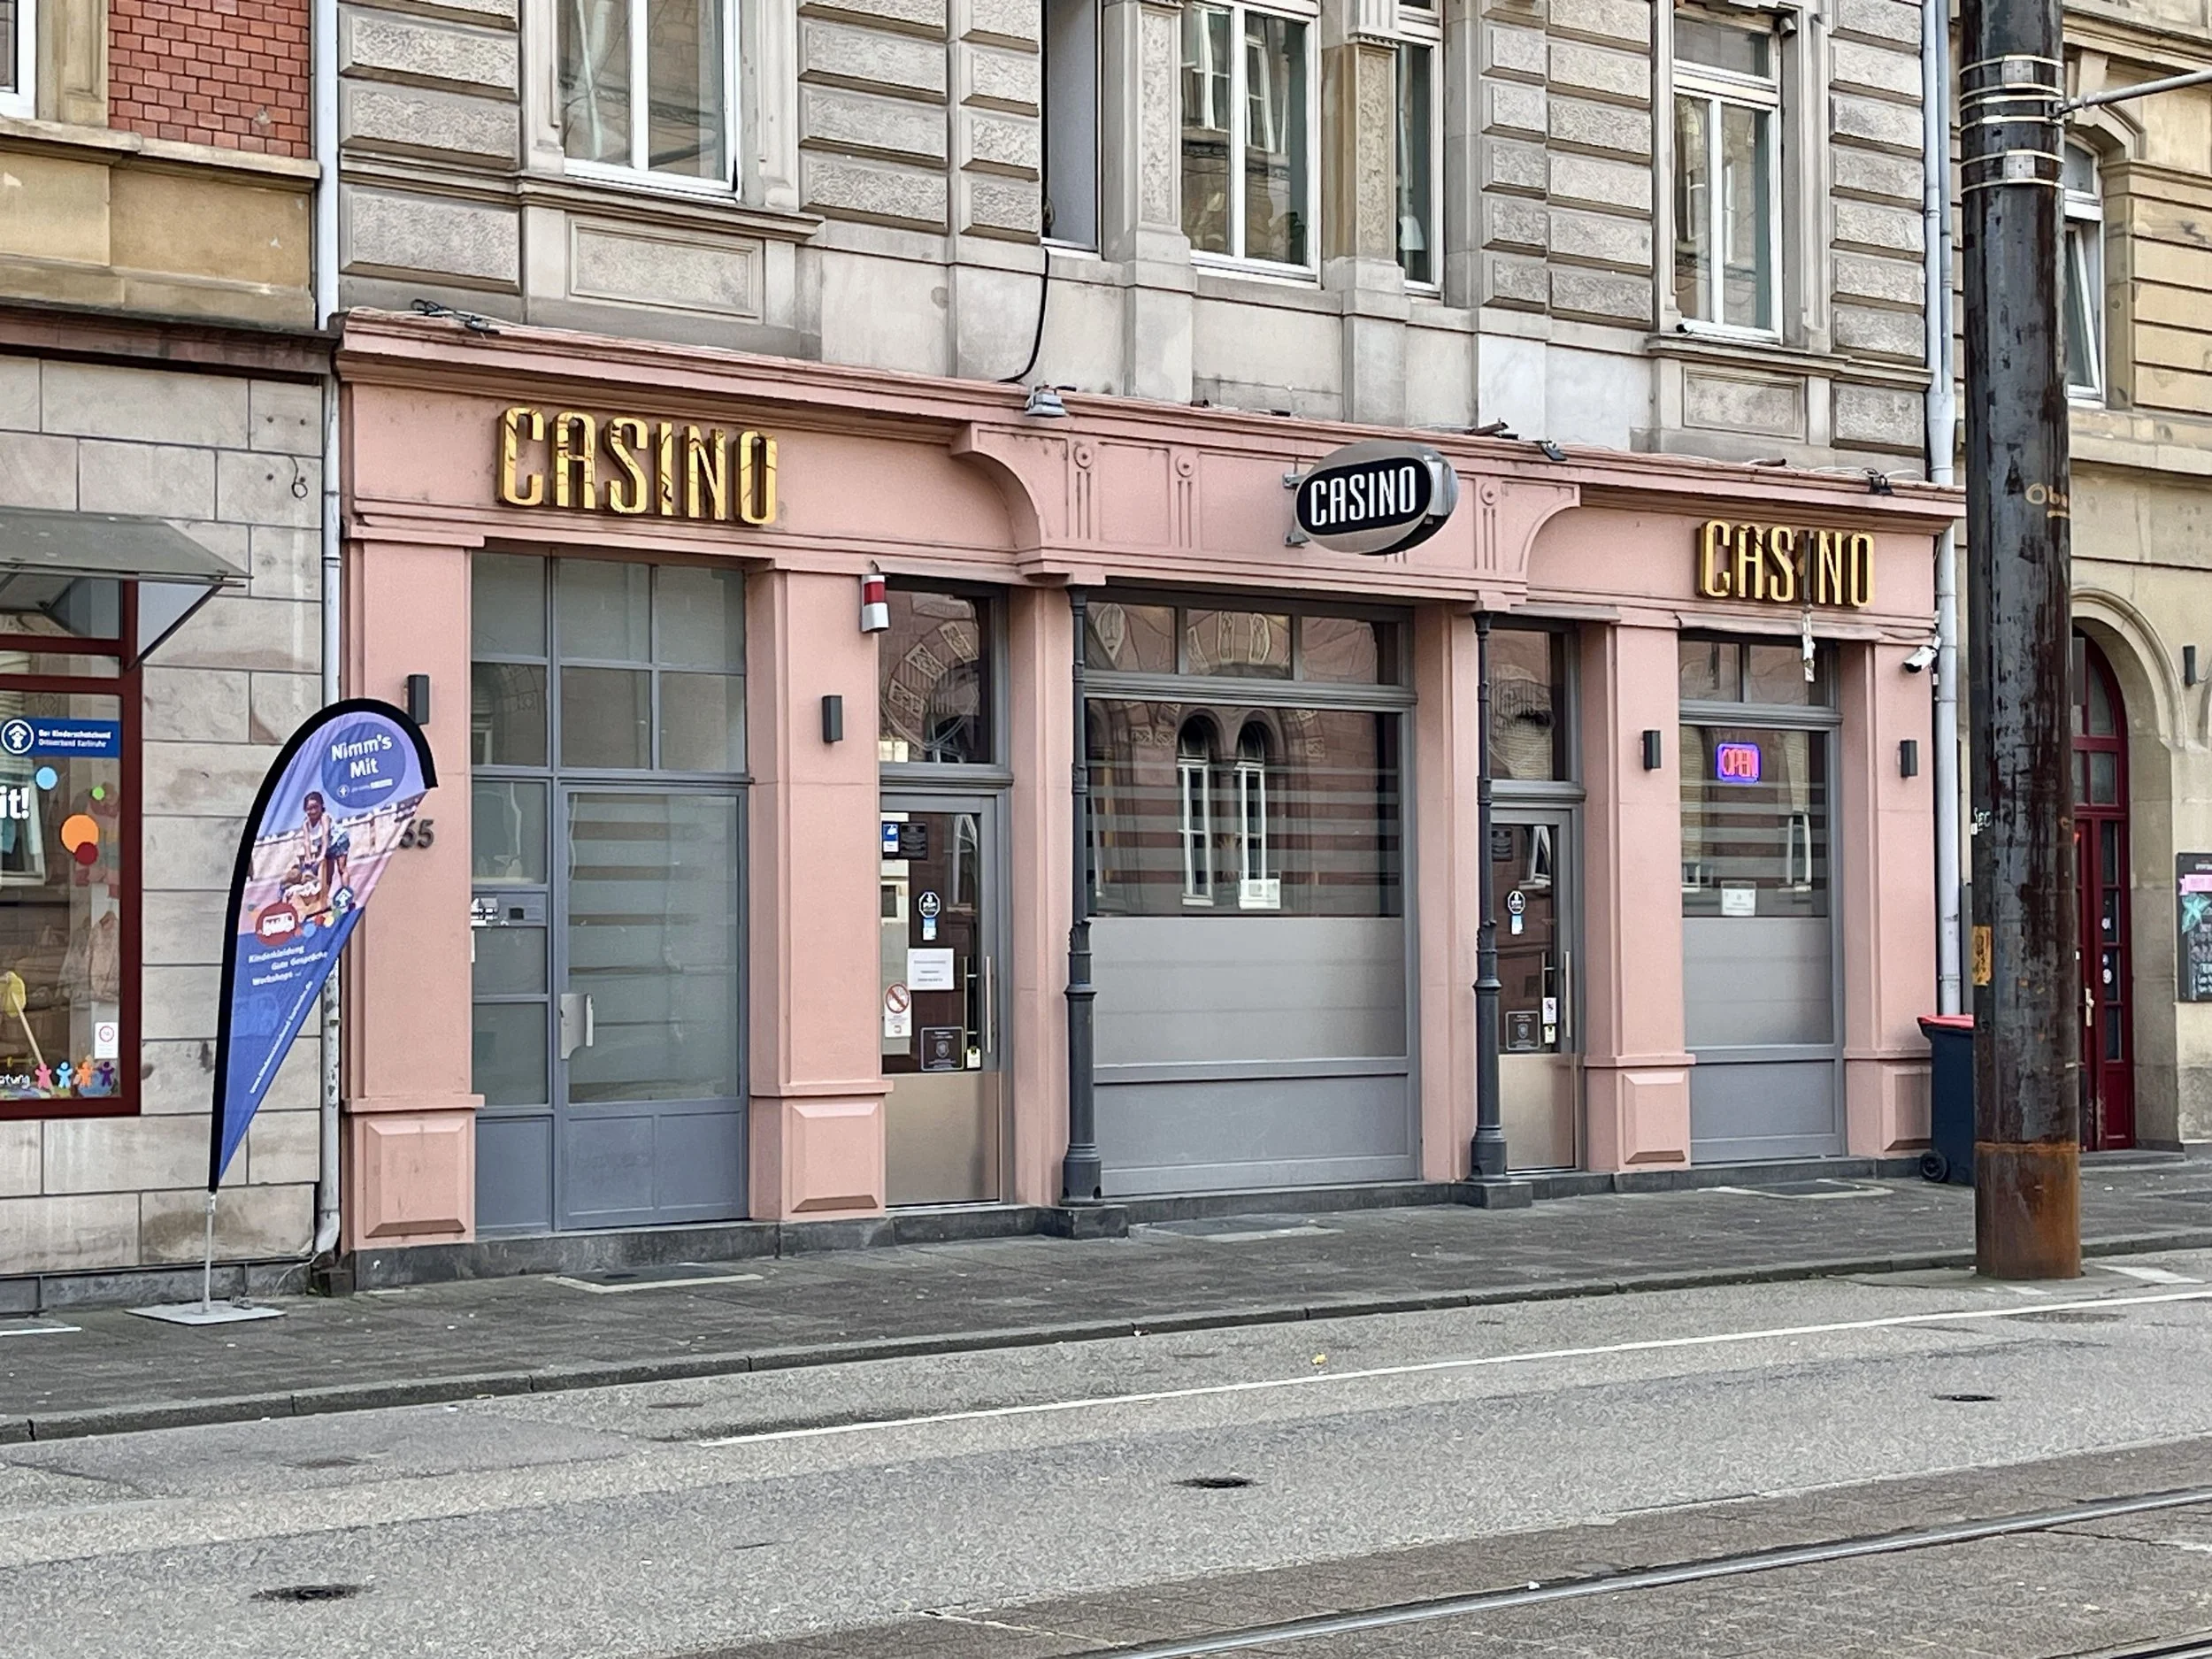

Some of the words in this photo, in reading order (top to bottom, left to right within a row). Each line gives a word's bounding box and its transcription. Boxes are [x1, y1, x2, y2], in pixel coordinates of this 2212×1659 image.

[498, 406, 778, 525] CASINO
[1310, 466, 1416, 526] CASINO
[331, 733, 392, 761] Nimm's
[350, 757, 379, 779] Mit
